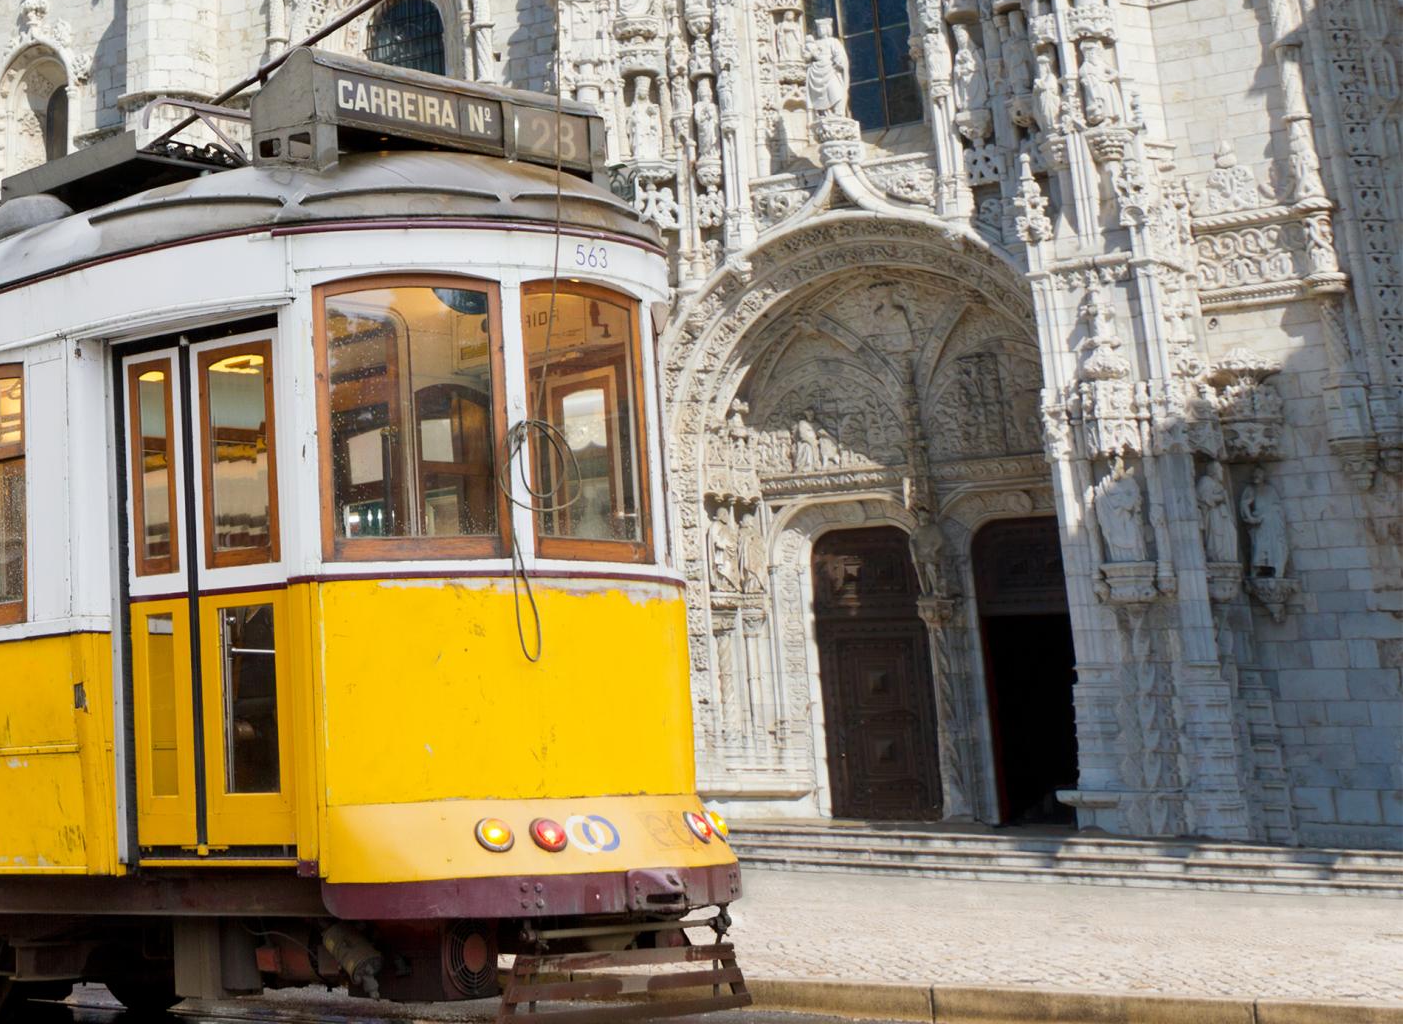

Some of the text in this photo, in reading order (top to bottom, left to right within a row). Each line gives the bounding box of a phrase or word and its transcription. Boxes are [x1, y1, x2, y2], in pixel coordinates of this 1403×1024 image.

[337, 79, 456, 129] CARREIRA
[531, 116, 576, 161] 28
[575, 243, 608, 269] 563
